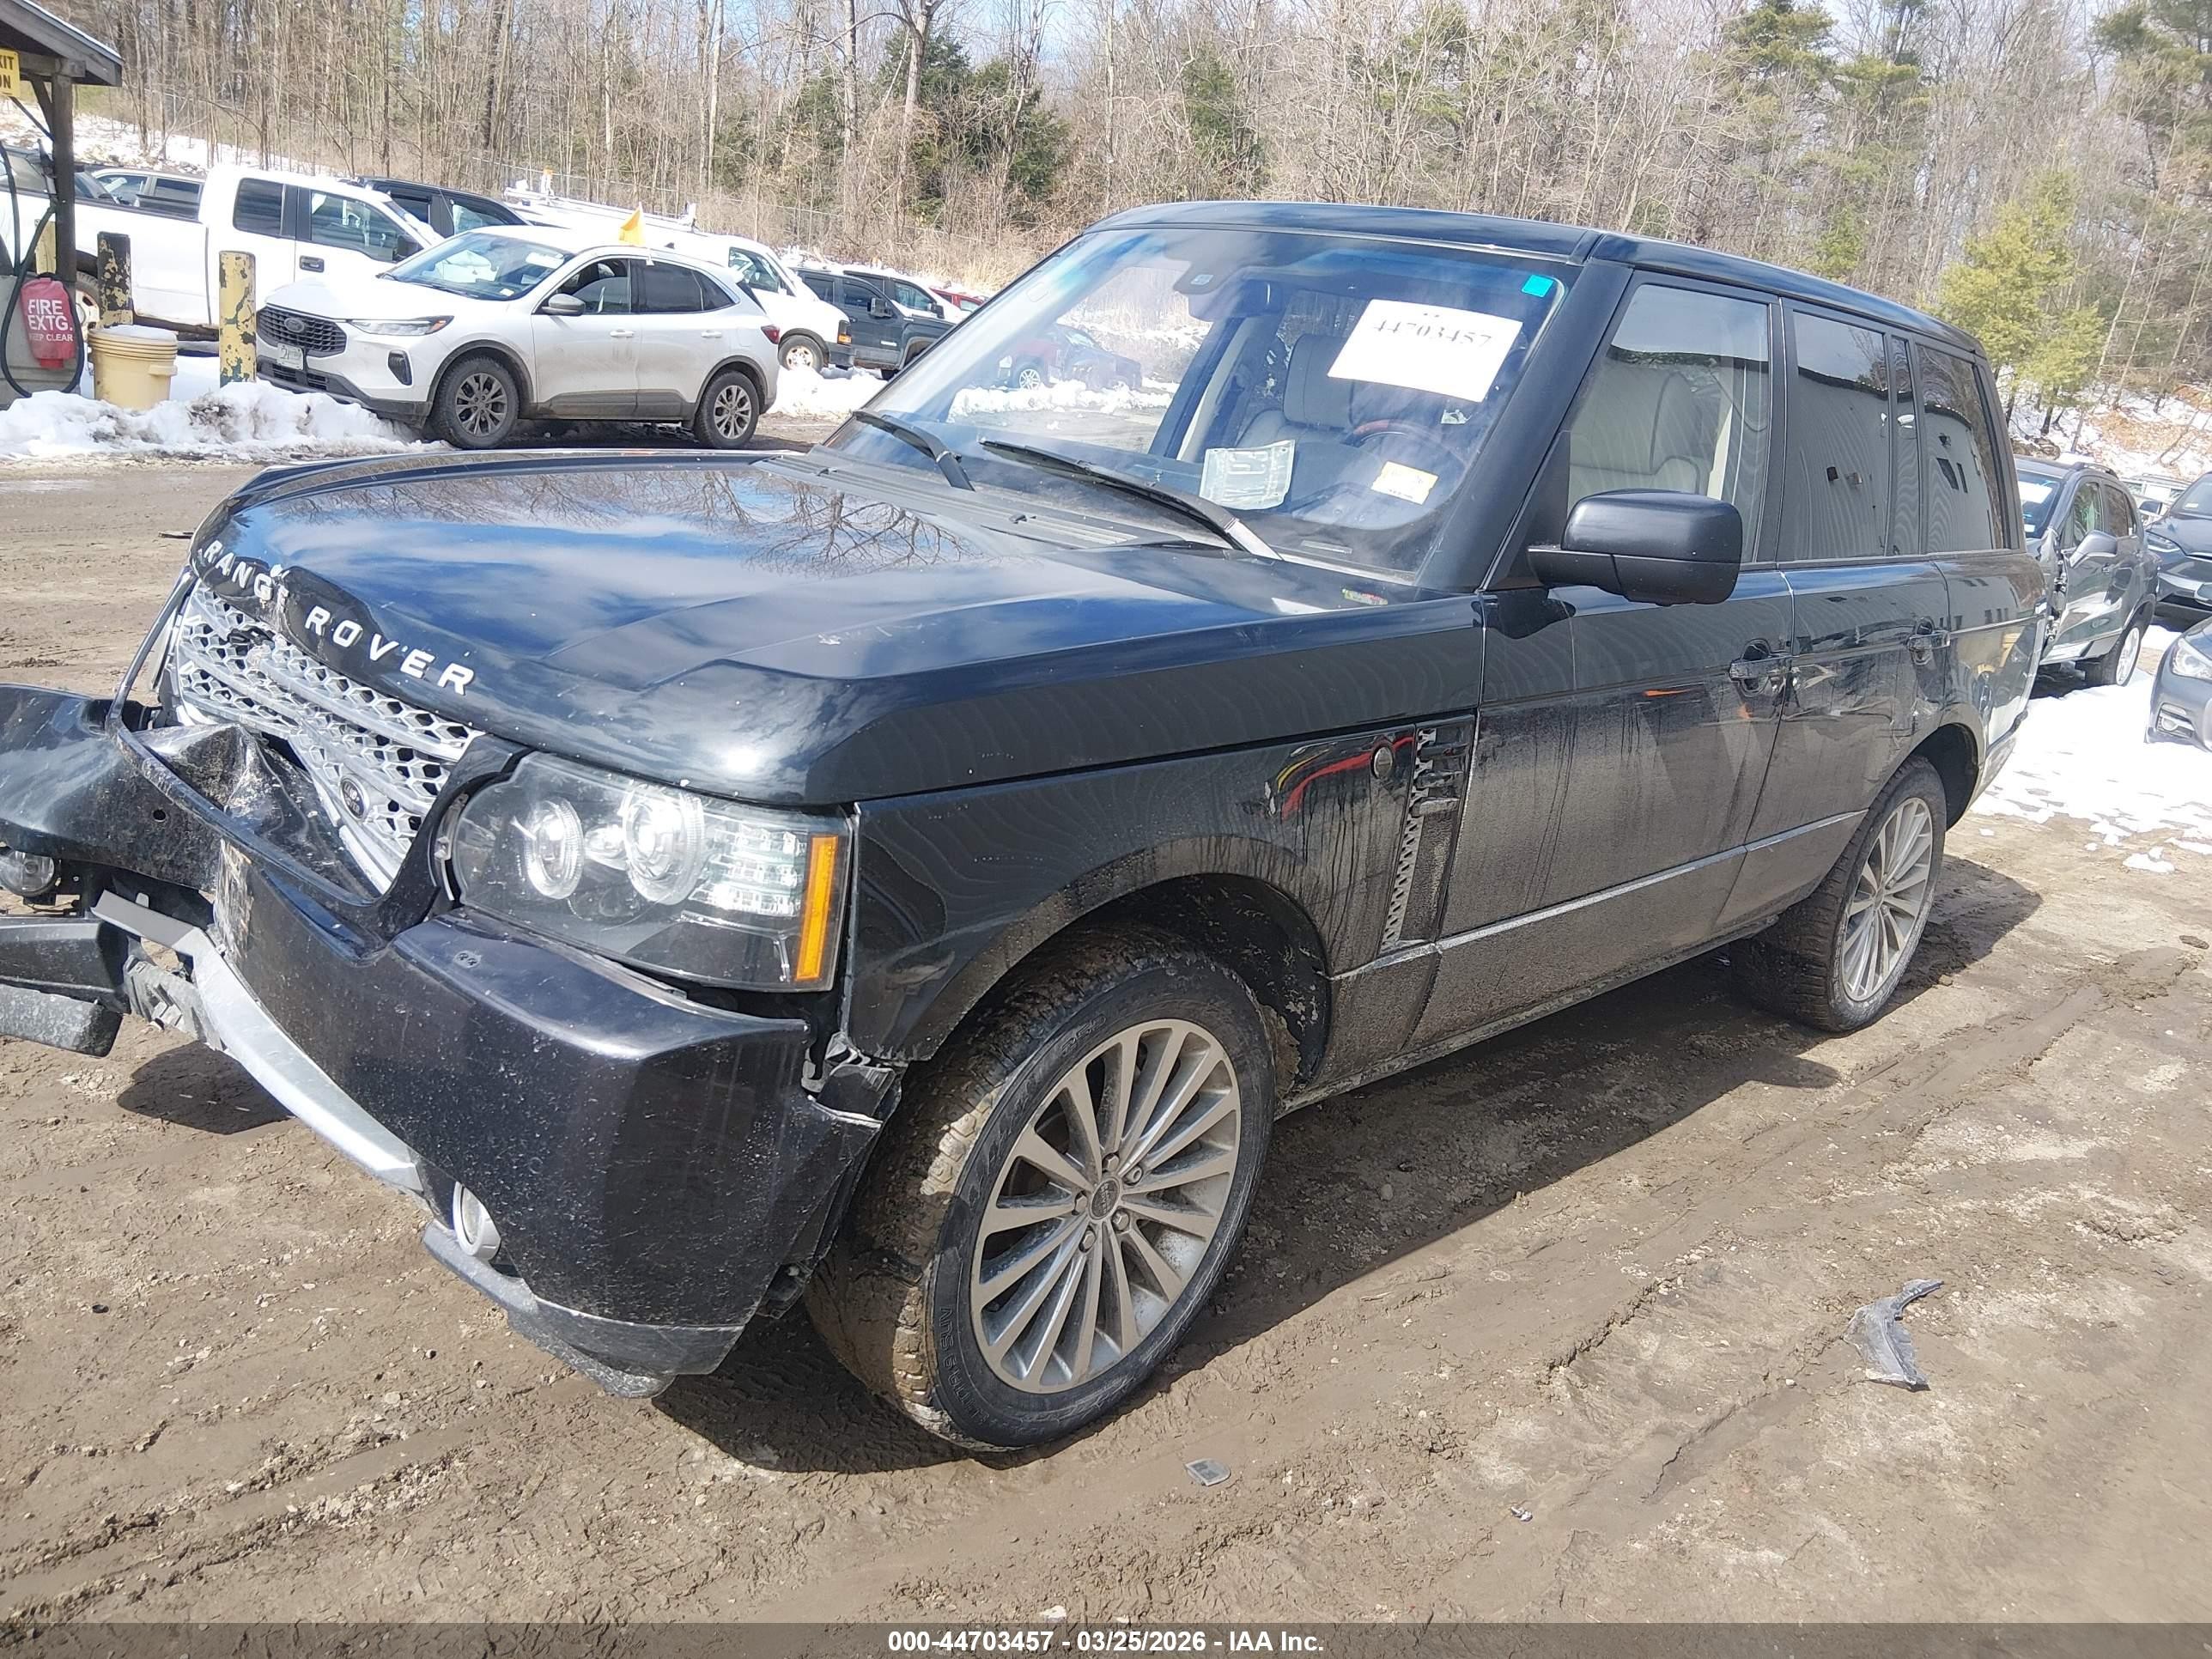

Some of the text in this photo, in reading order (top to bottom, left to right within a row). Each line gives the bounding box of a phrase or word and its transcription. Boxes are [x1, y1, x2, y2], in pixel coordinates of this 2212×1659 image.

[28, 299, 64, 315] FIRE
[27, 315, 73, 331] EXTG.
[46, 333, 73, 342] CLEAR
[305, 605, 475, 696] ROVER
